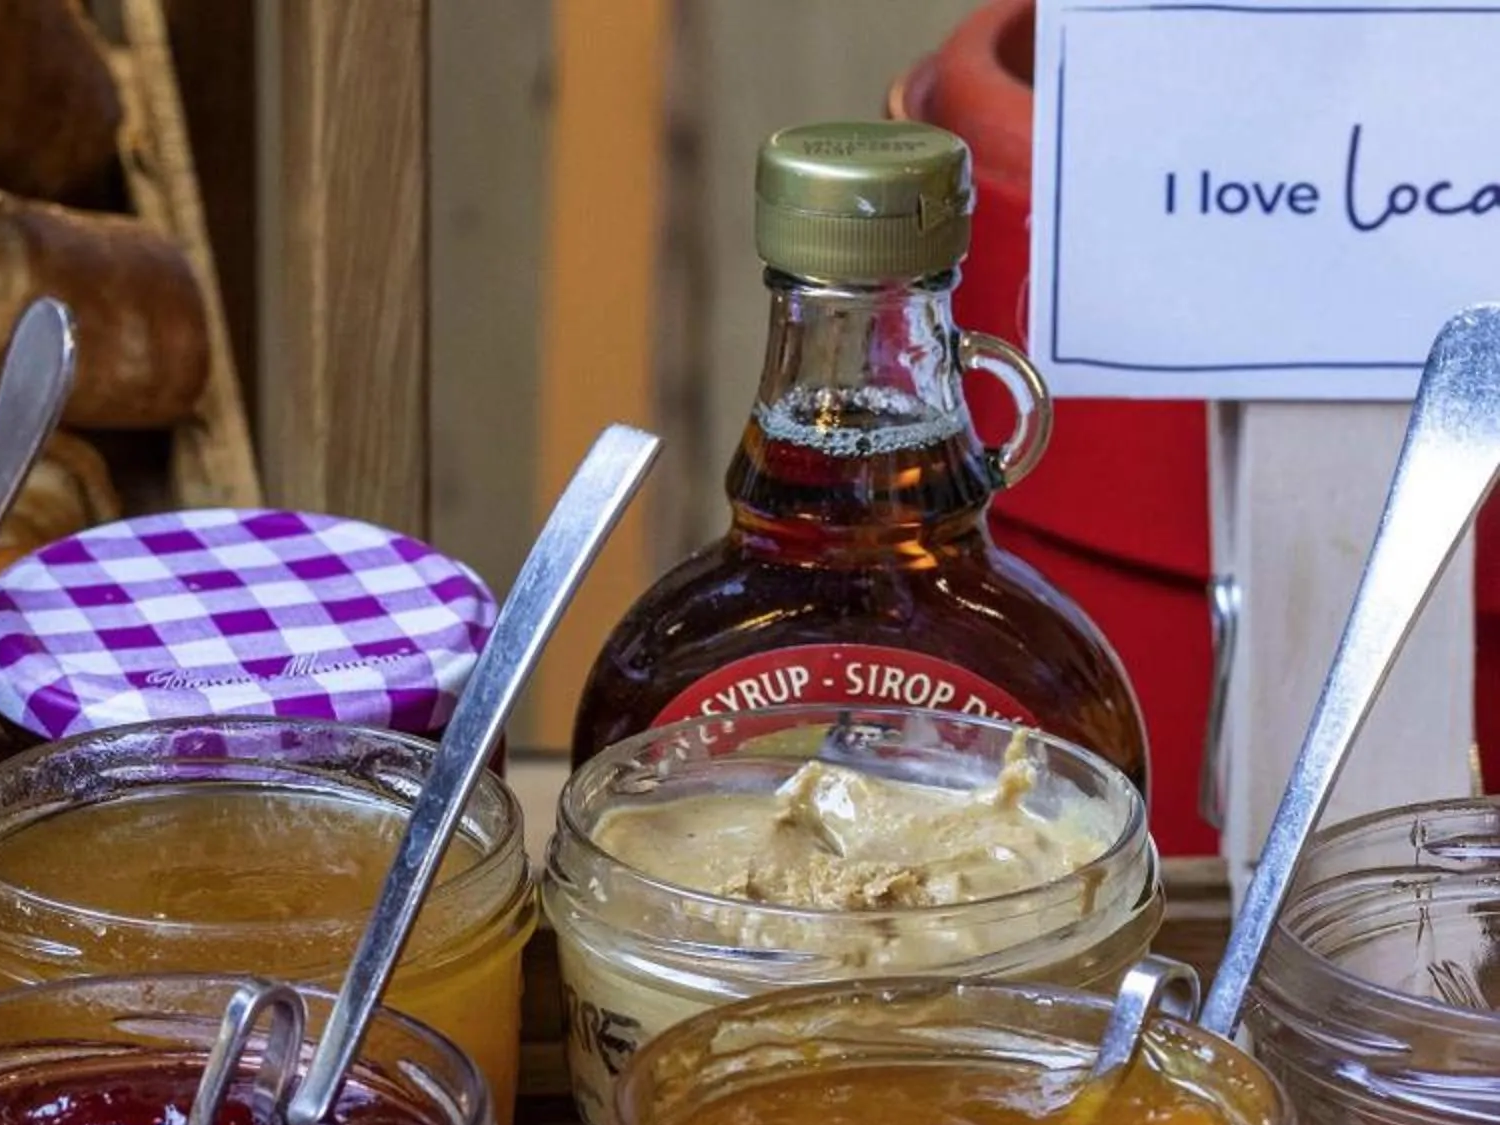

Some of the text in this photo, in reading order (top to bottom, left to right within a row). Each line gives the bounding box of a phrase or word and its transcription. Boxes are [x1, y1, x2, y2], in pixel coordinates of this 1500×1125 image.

[1164, 123, 1500, 233] I love Loca
[701, 662, 955, 717] SYRUP SIROP
